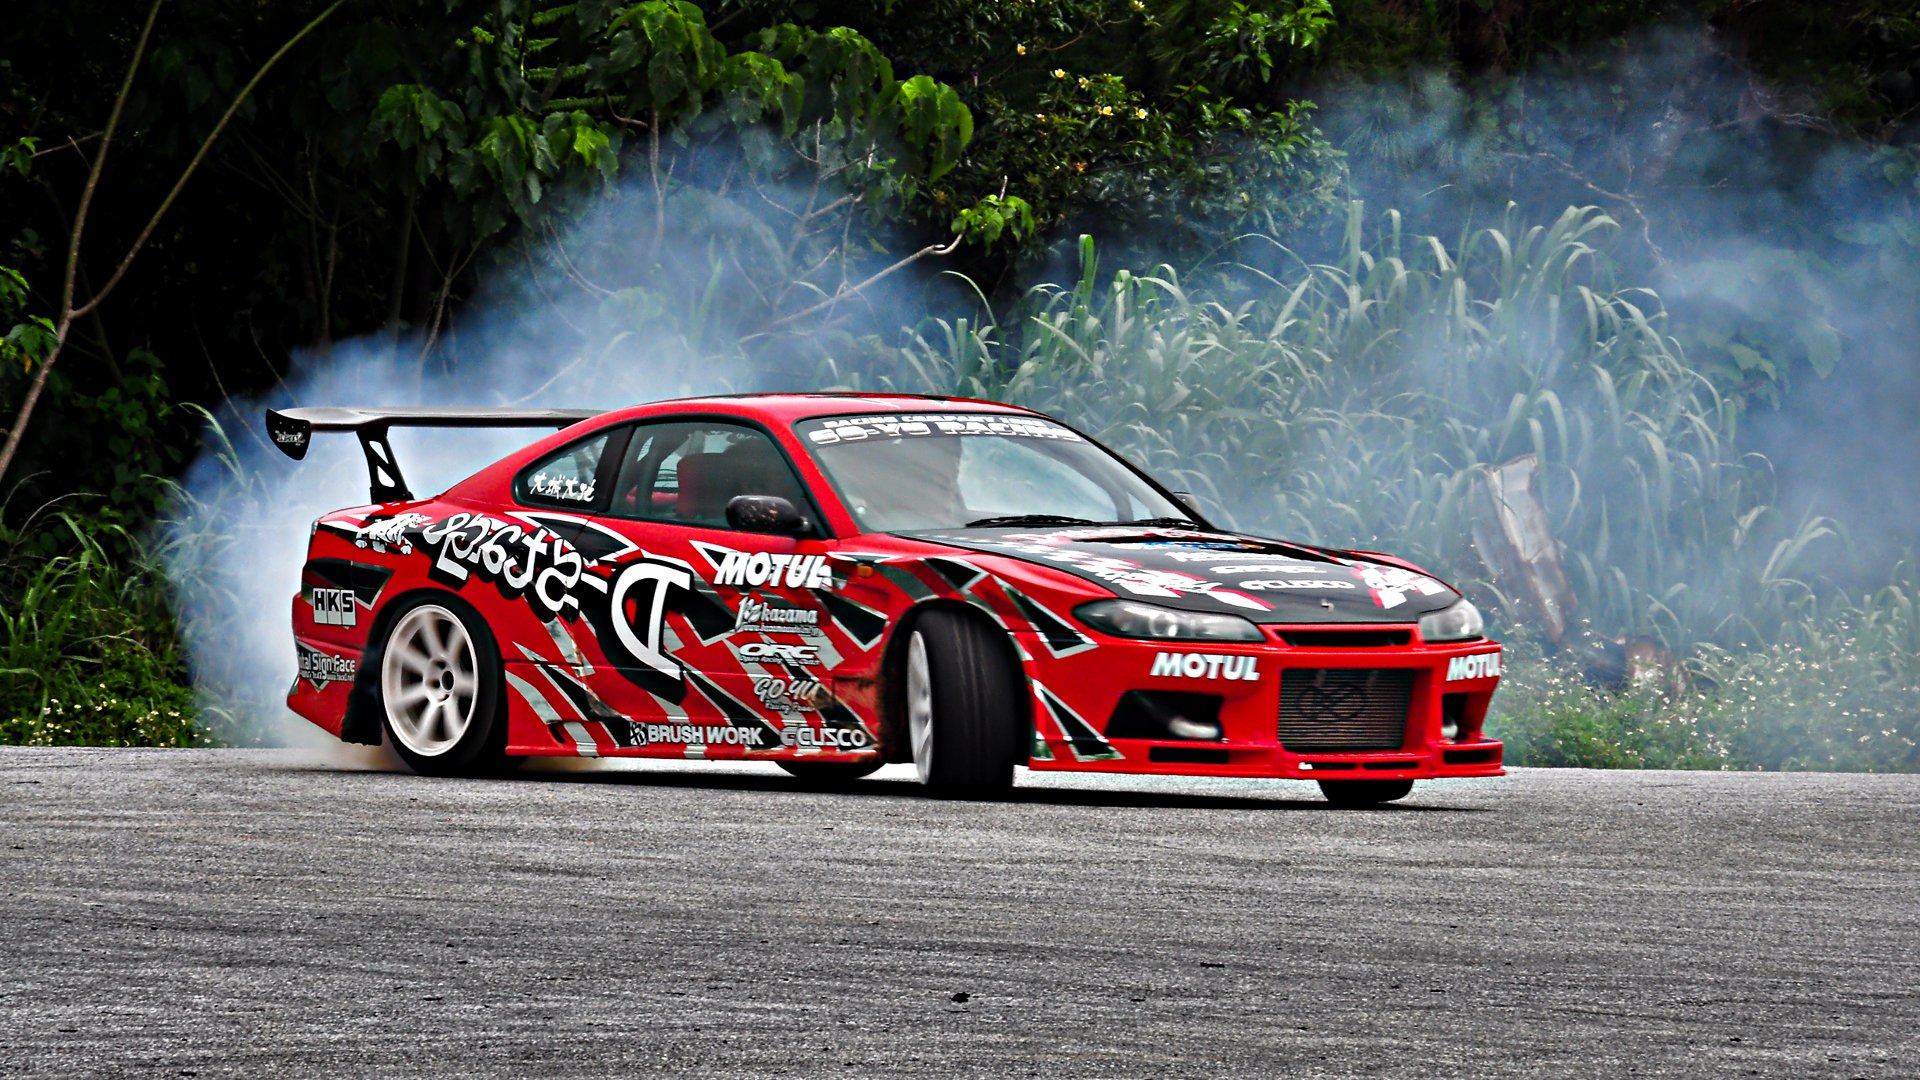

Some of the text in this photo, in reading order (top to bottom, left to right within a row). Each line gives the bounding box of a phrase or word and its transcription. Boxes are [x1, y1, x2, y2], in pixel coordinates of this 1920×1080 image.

[713, 551, 834, 589] MOTUL
[314, 590, 355, 613] HKS
[739, 643, 819, 666] ORC
[1150, 652, 1260, 681] MOTUL
[647, 724, 764, 745] BRUSH WORK
[797, 727, 867, 747] CUSCO
